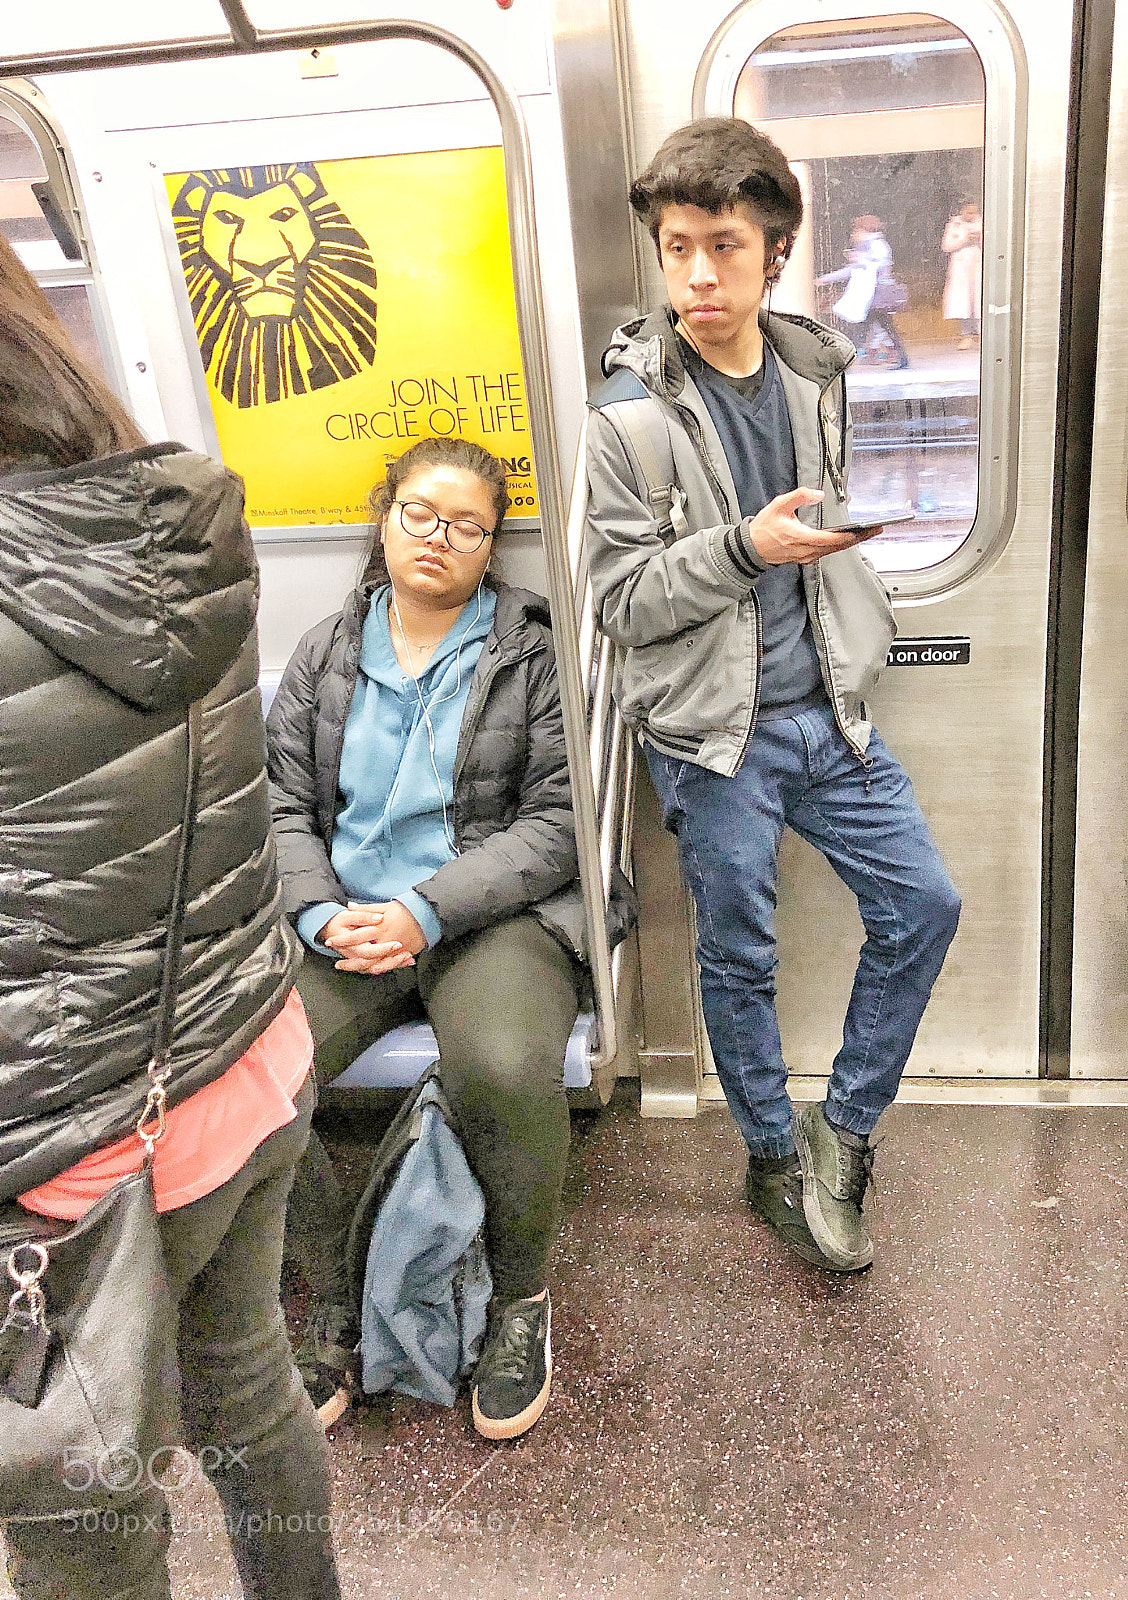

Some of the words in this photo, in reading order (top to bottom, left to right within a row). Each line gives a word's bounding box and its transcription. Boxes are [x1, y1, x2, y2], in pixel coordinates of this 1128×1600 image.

[388, 376, 459, 408] JOIN
[465, 373, 522, 402] THE
[325, 409, 420, 441] CIRCLE
[428, 407, 469, 435] OF
[345, 505, 352, 513] &
[896, 650, 918, 663] on
[920, 647, 961, 662] door
